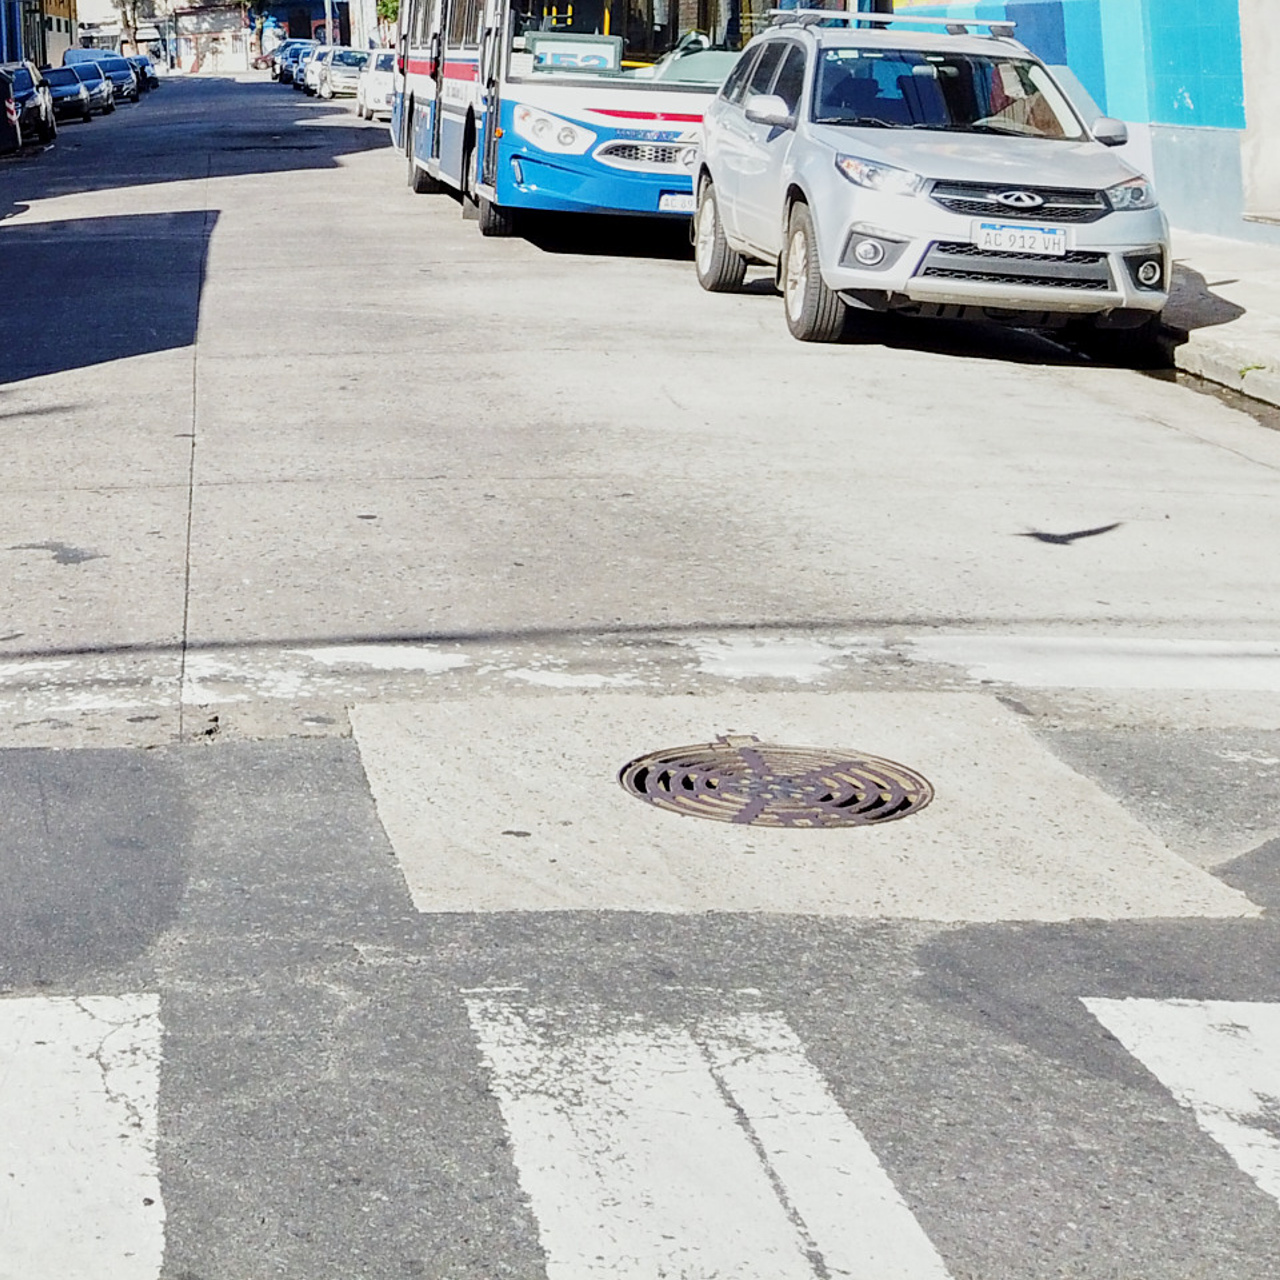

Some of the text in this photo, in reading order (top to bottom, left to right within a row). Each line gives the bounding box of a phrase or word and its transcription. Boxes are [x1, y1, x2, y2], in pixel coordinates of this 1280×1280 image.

[538, 52, 609, 69] 152
[984, 232, 1062, 252] AC 912 VH
